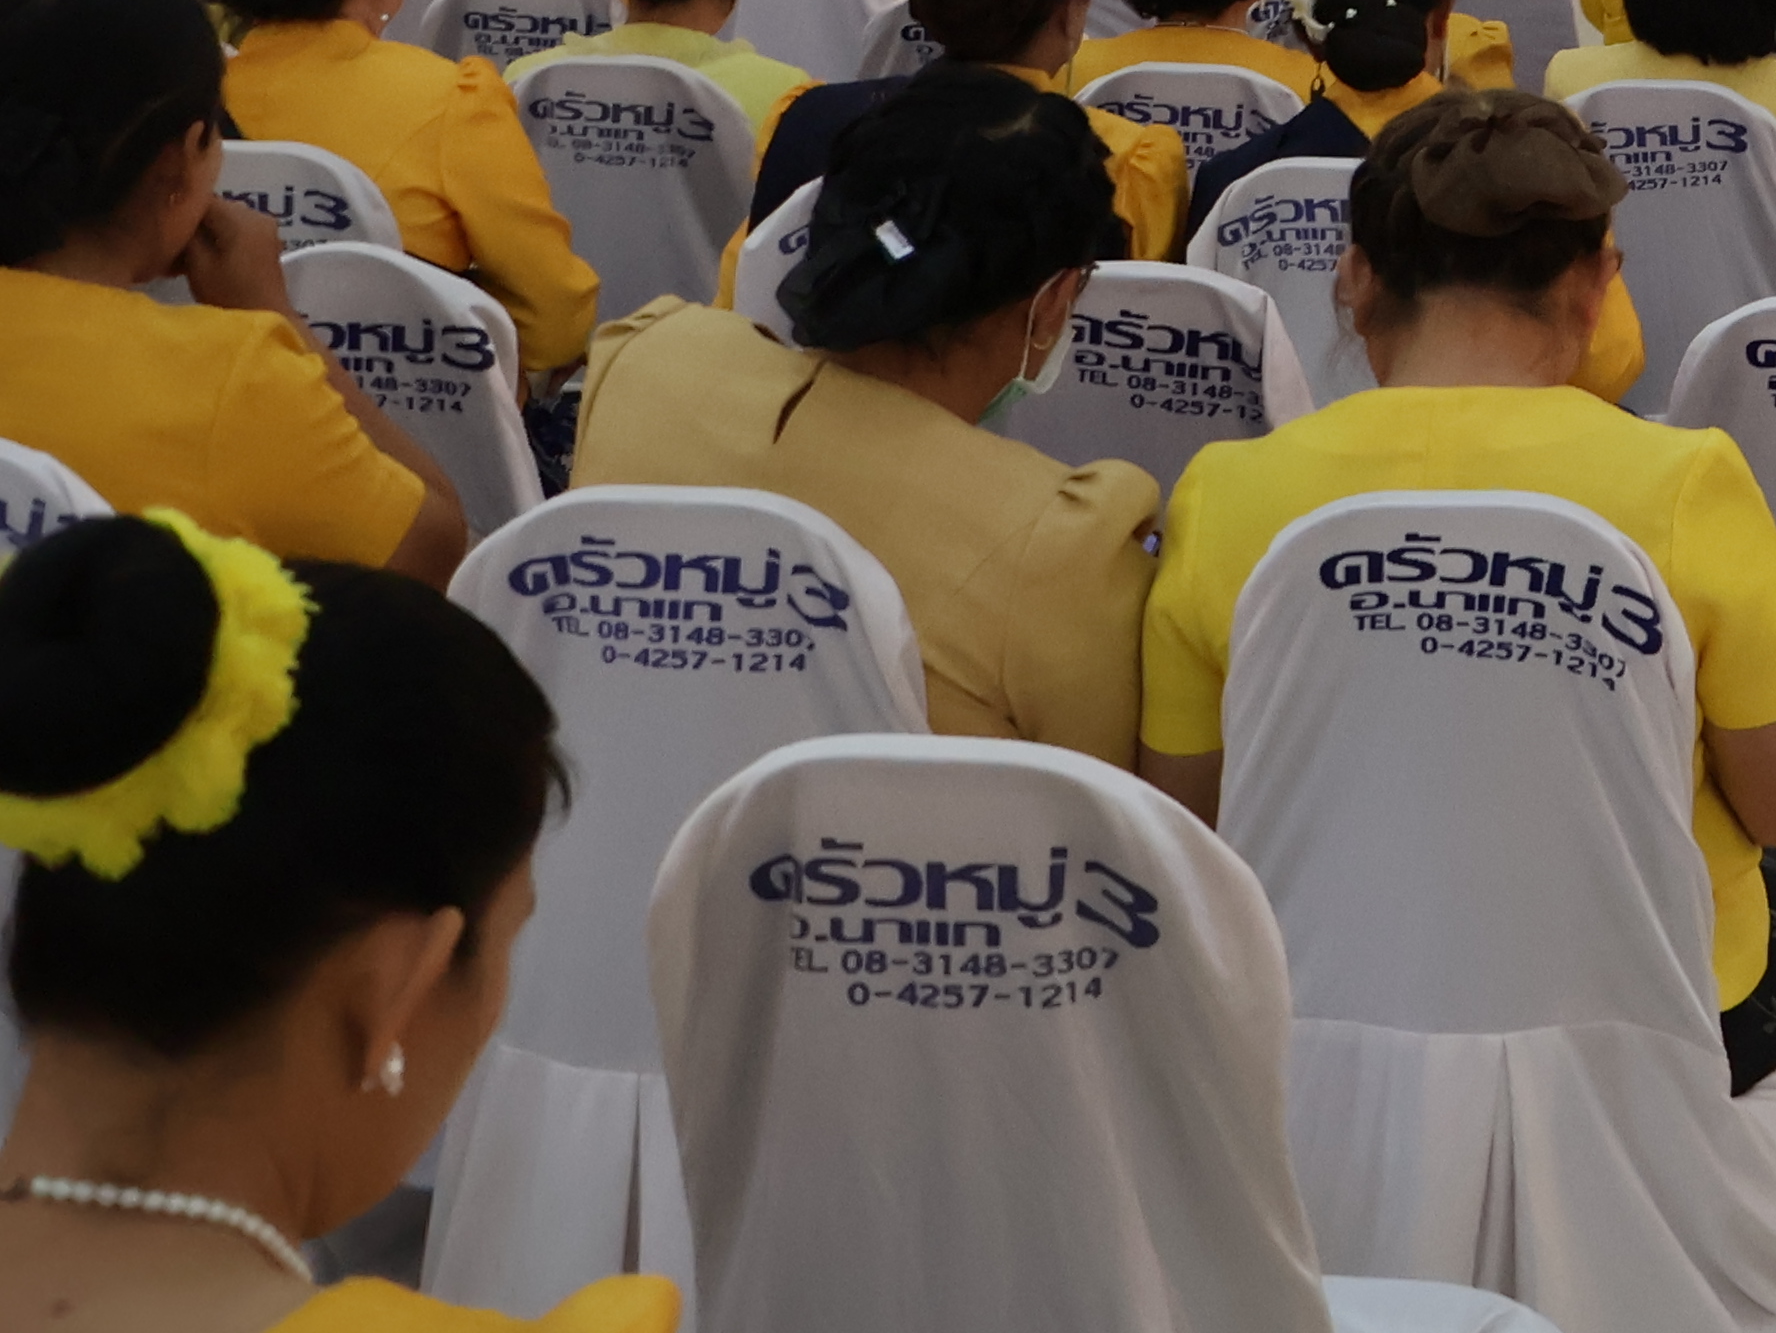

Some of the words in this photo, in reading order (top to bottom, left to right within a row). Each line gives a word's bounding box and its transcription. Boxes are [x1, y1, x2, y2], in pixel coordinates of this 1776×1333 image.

[1622, 161, 1728, 176] -3148-3307
[1628, 174, 1722, 191] 4257-1214
[1273, 243, 1347, 257] 08-3148
[1278, 259, 1337, 271] 0-4257
[357, 376, 471, 397] 148-3307
[1127, 375, 1260, 405] 08-3148-3
[376, 394, 463, 412] 7-1214
[1130, 394, 1263, 422] 0-4257-12
[1416, 613, 1626, 678] 08-3148-3307
[603, 646, 806, 672] 0-4257-1214
[1421, 636, 1616, 691] 0-4257-1214
[842, 947, 1118, 978] 08-3148-3307
[848, 977, 1102, 1009] 0-4257-1214
